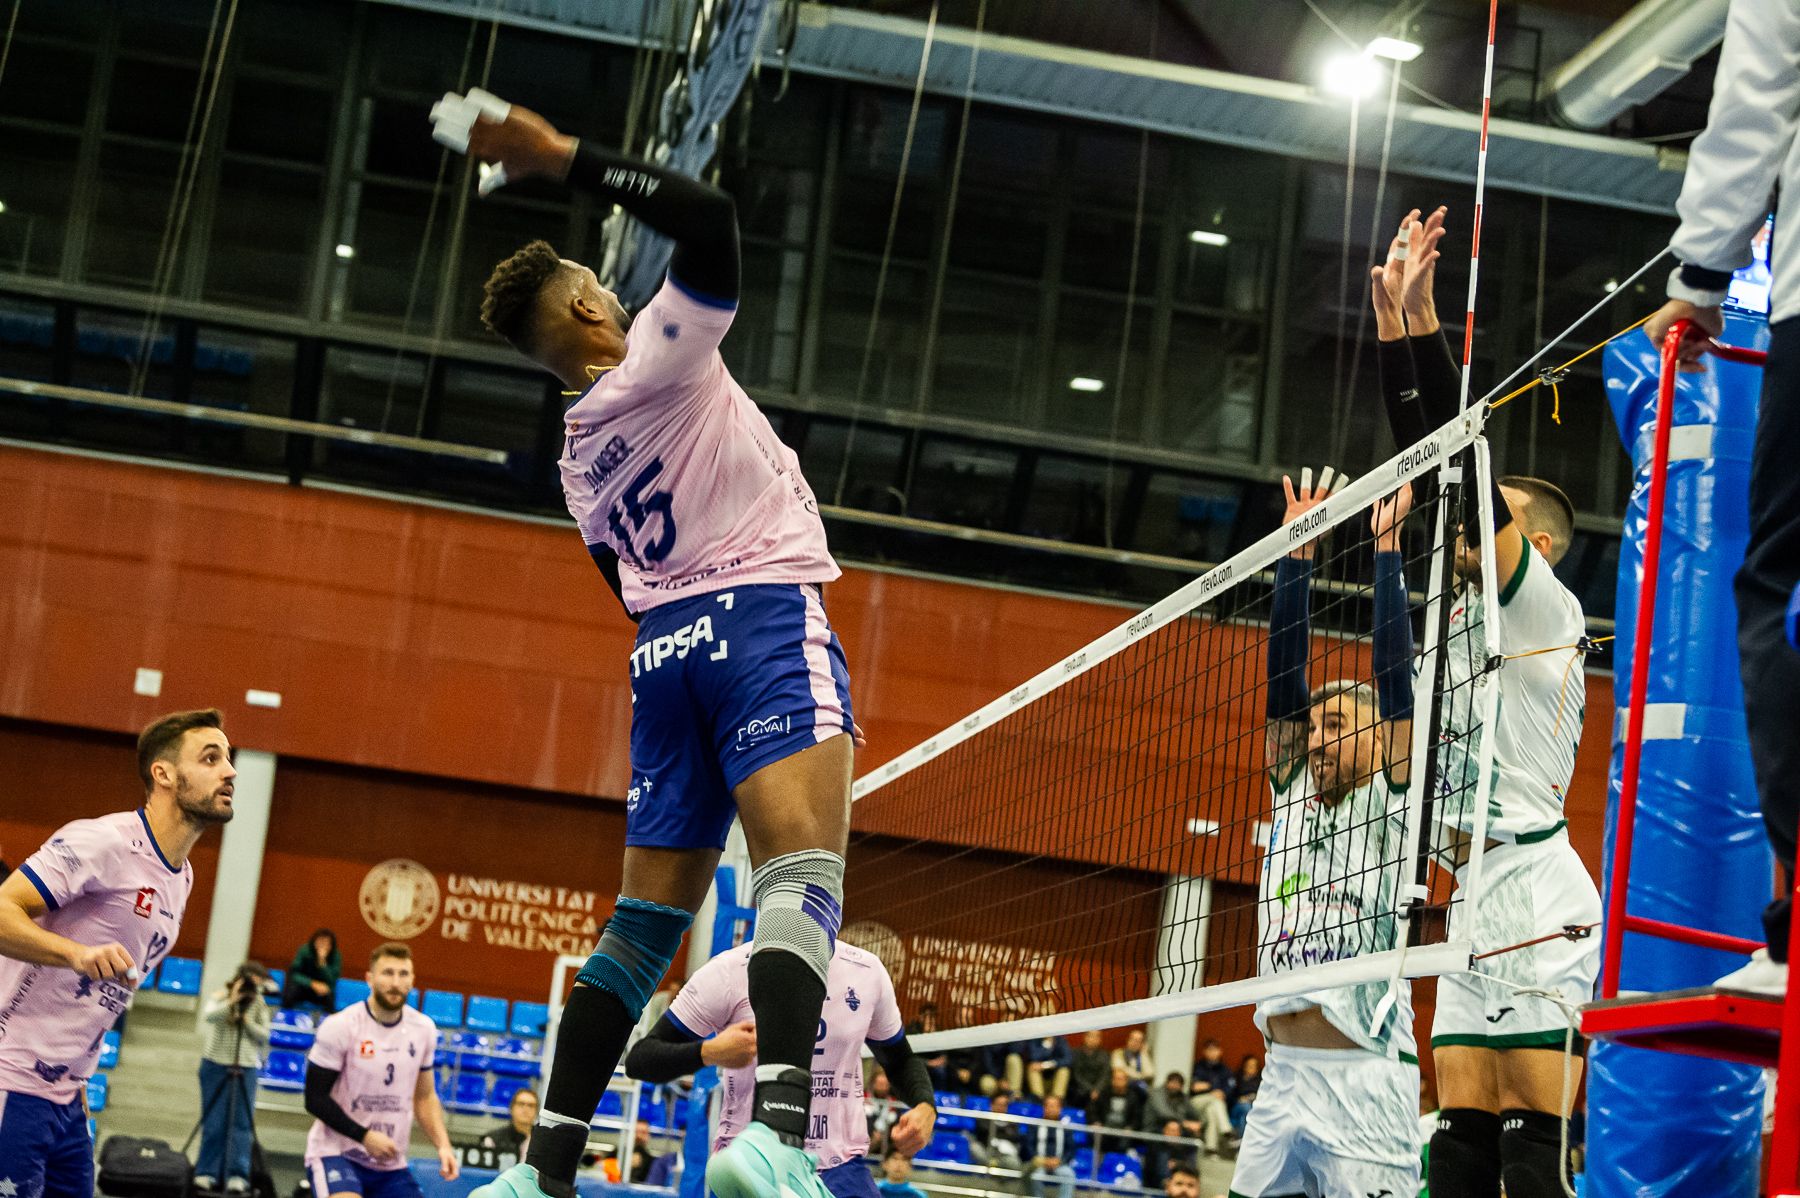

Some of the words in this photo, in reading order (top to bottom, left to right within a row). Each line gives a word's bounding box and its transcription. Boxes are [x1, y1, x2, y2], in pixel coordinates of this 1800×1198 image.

[608, 456, 677, 571] 15
[1289, 506, 1327, 542] rfevb.com
[631, 615, 714, 678] TIPSA
[447, 874, 596, 912] UNIVERSITAT
[441, 919, 471, 942] DE
[384, 1063, 394, 1086] 3
[810, 1077, 835, 1087] ITAT
